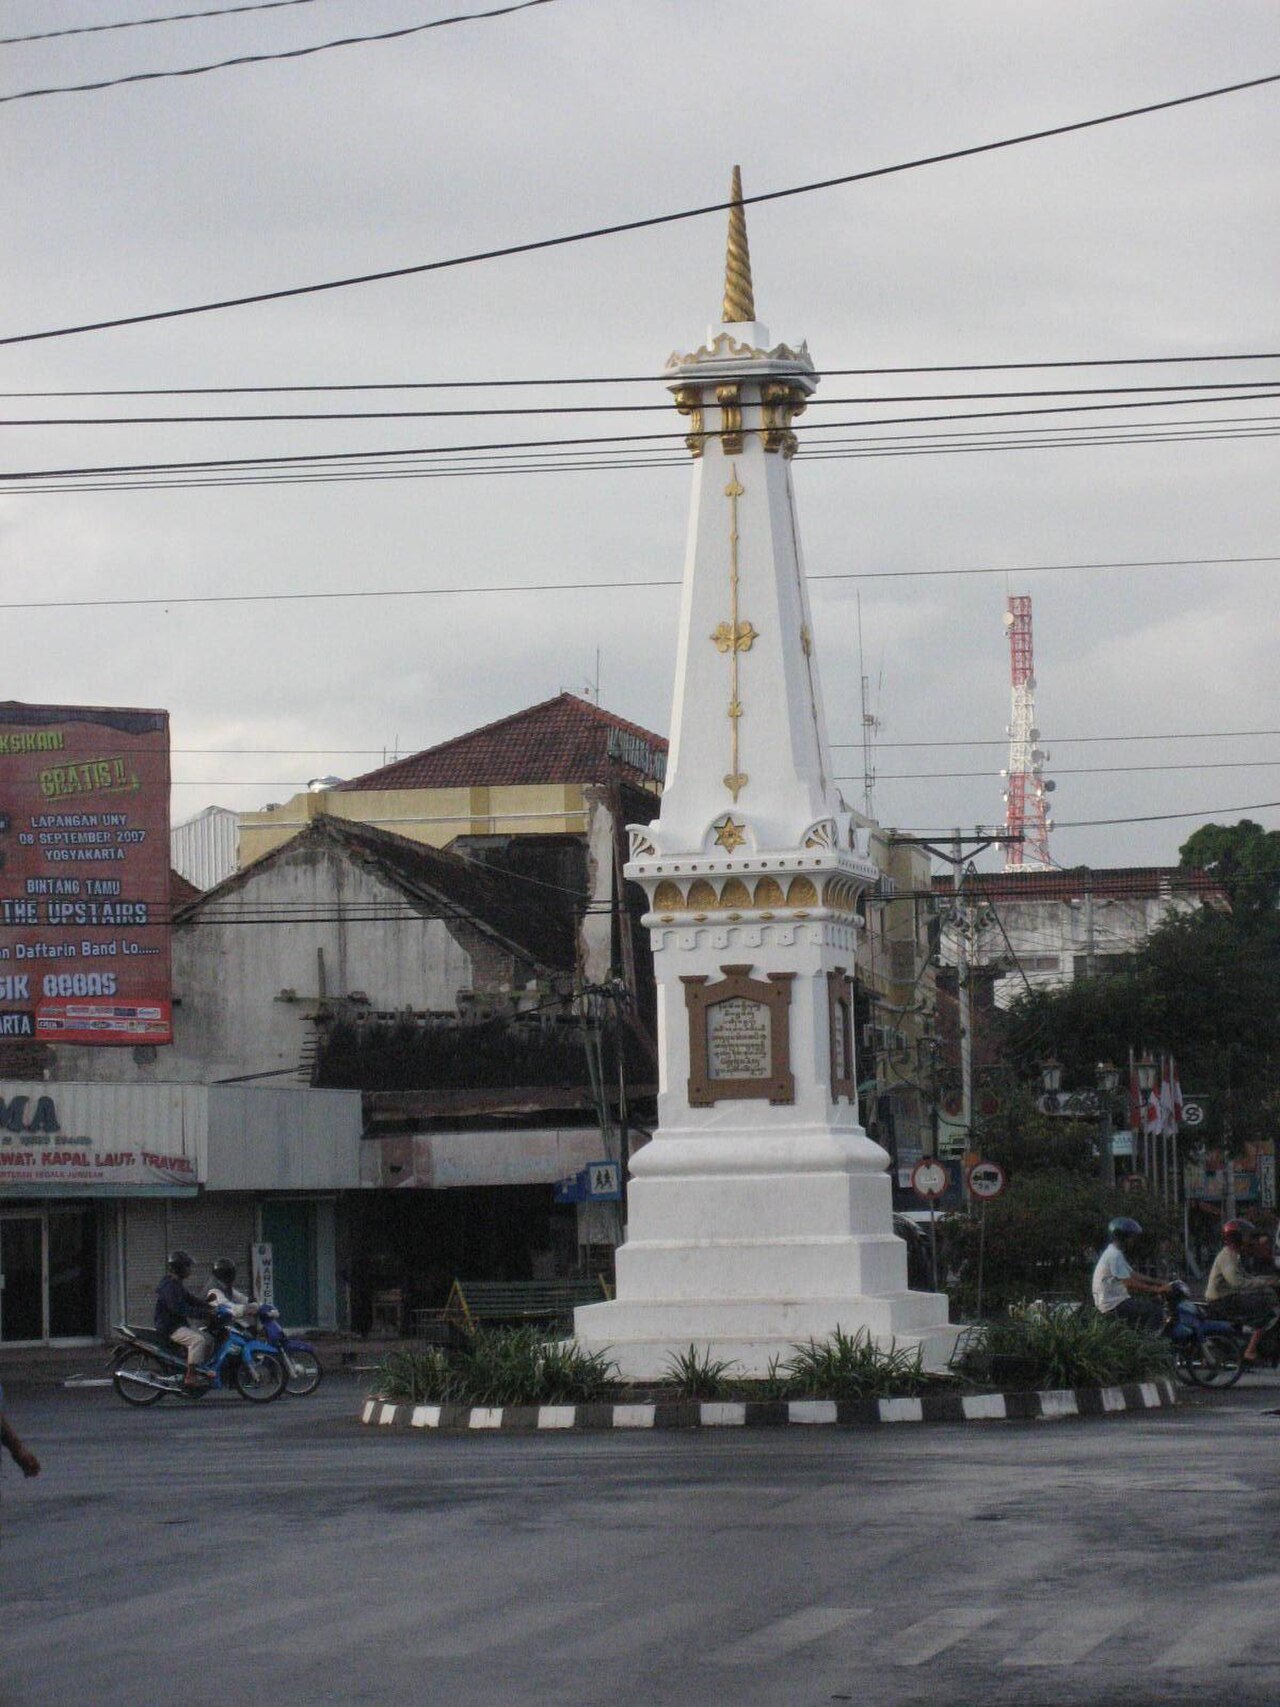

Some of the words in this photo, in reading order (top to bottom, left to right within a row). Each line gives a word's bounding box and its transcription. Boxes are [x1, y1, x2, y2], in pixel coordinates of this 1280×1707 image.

[31, 814, 98, 828] LAPANGAN
[103, 814, 127, 827] UNY
[39, 832, 111, 845] SEPTEMBER
[117, 831, 146, 843] 2007
[45, 849, 125, 861] YOGYAKARTA
[27, 880, 79, 894] BINTANG
[86, 881, 120, 894] TAMU
[1, 900, 38, 923] THE
[48, 901, 147, 924] UPSTAIRS
[16, 944, 76, 959] Daftarin
[82, 940, 117, 956] Band
[41, 1152, 90, 1166] KAPAL
[140, 1152, 194, 1173] TRAVEL
